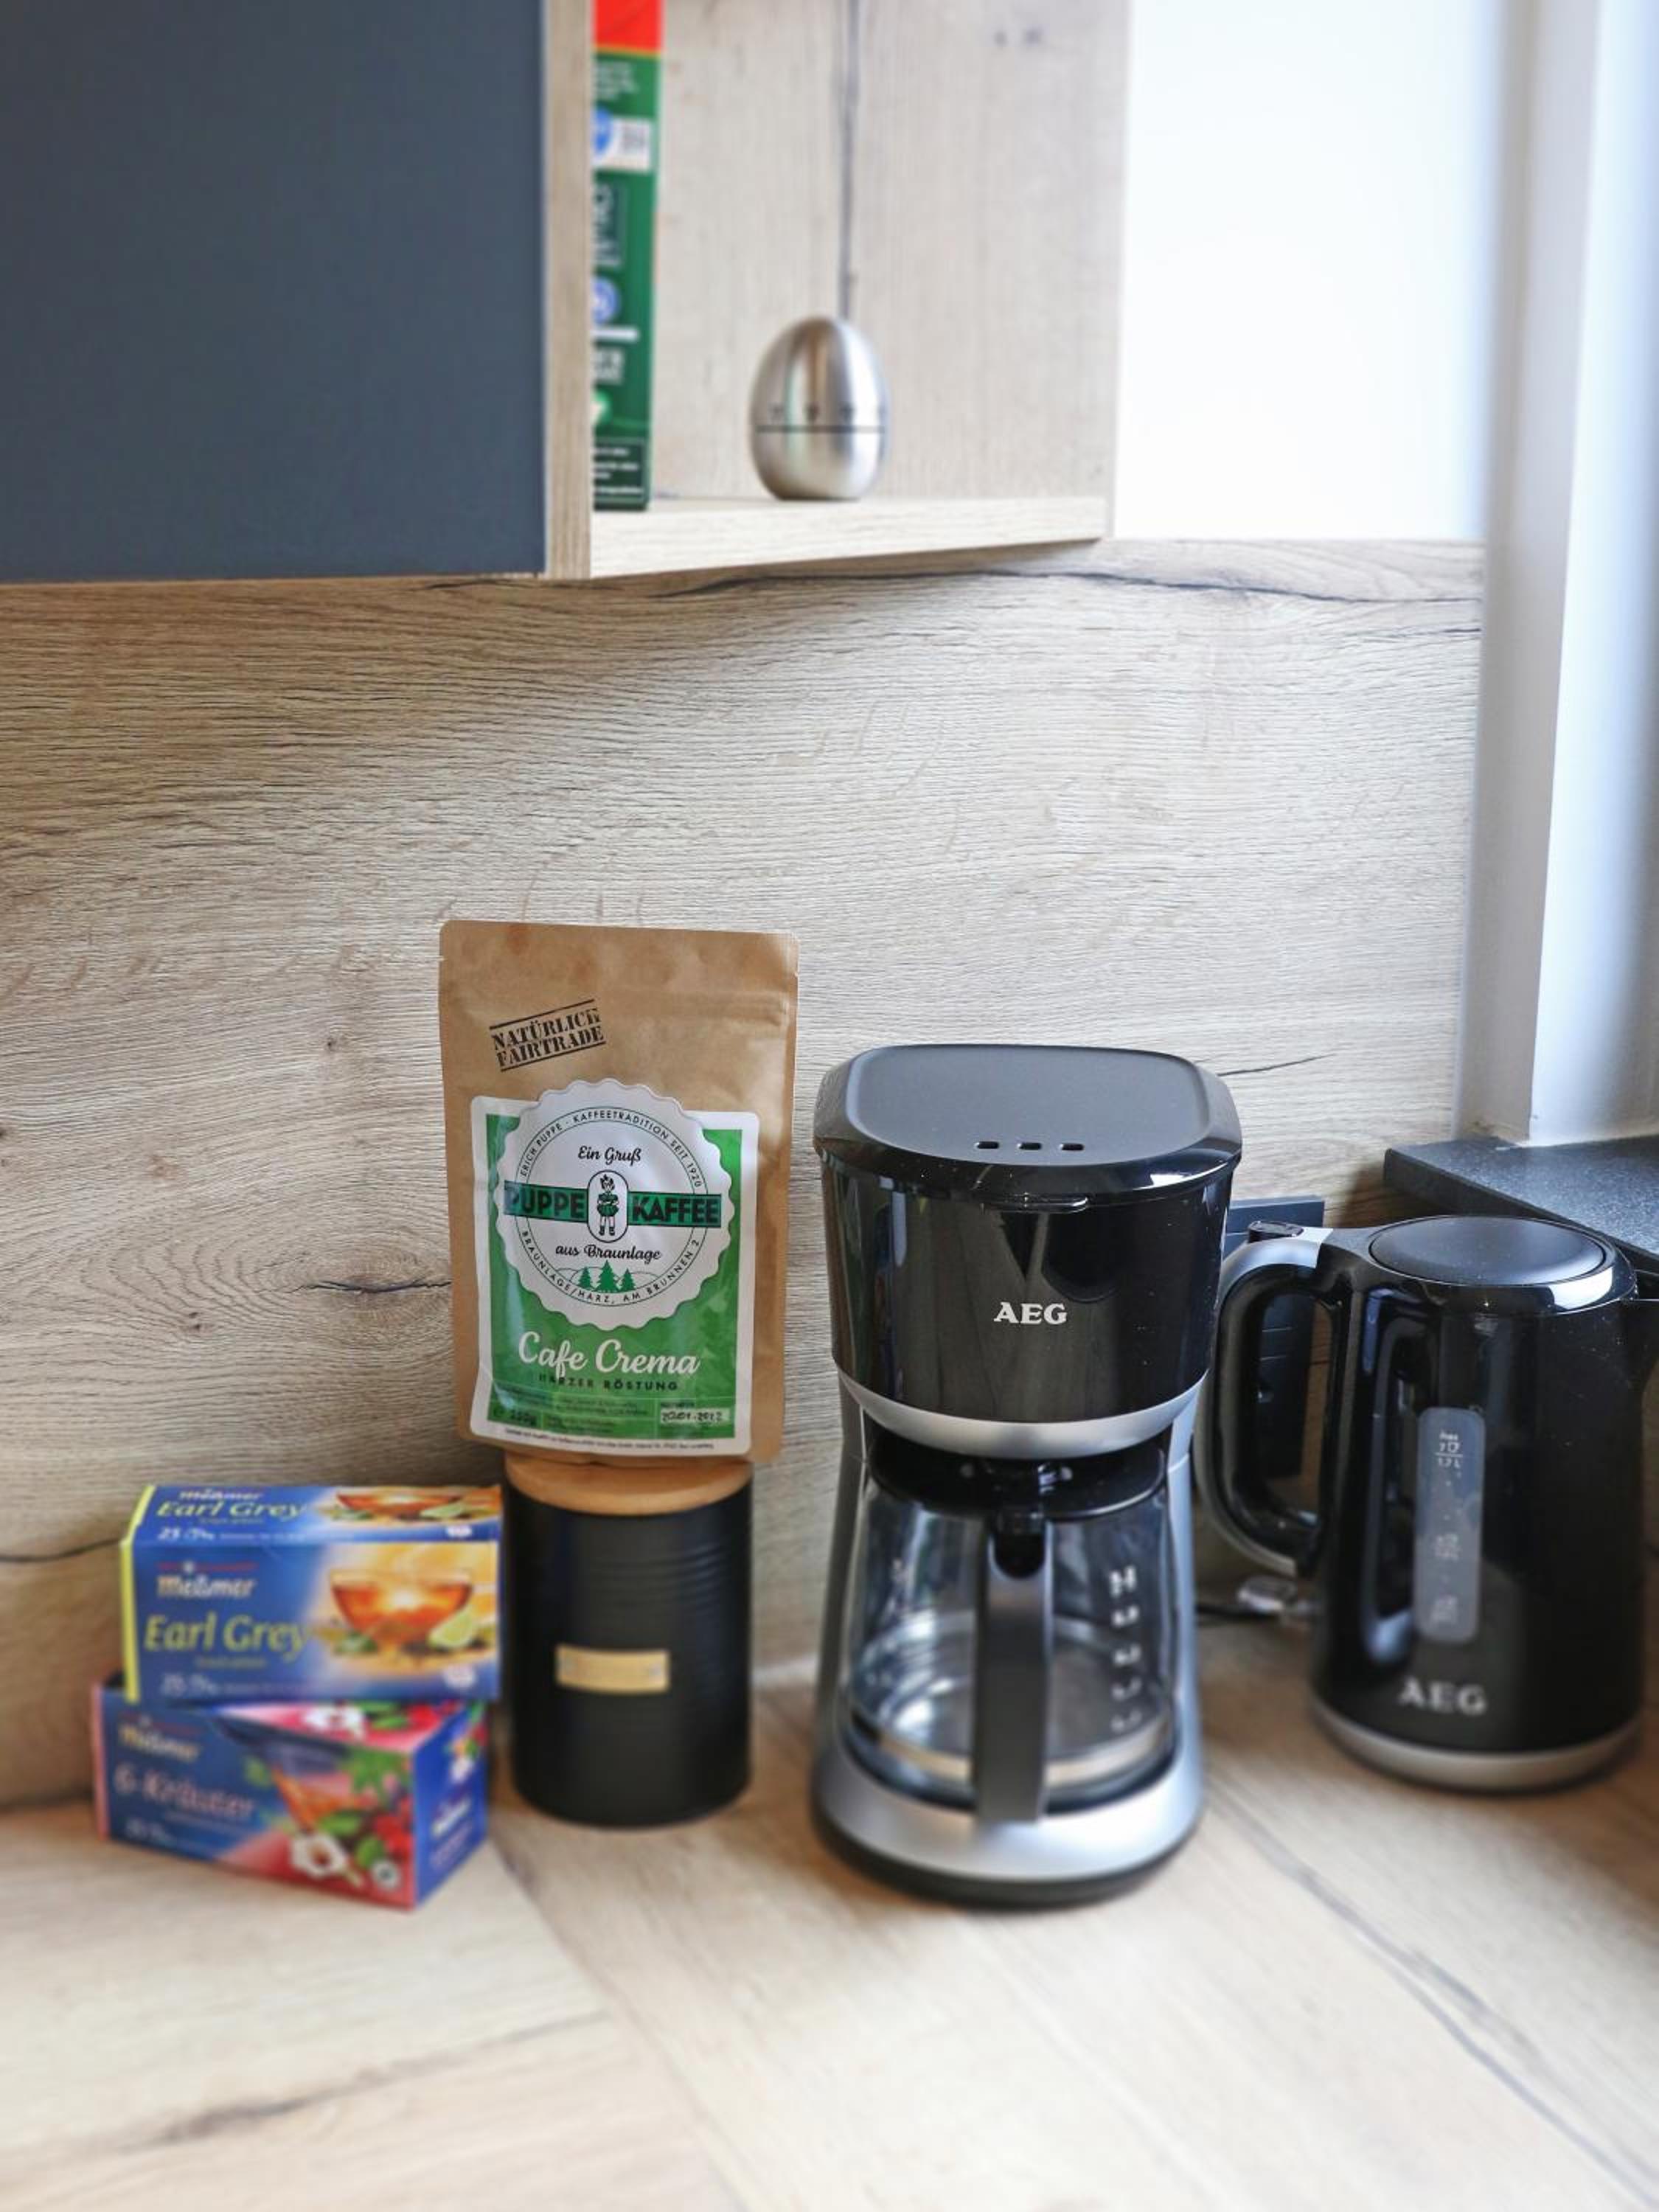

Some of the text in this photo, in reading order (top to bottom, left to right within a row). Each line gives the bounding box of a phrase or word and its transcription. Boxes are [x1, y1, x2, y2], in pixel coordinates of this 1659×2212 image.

[496, 1026, 604, 1068] FAIRTRADE
[521, 1148, 538, 1178] ERICH
[536, 1123, 563, 1147] PUPPE
[572, 1110, 669, 1140] KAFFEETRADITION
[670, 1139, 689, 1160] SEIT
[577, 1145, 641, 1166] Ein Gruß
[632, 1194, 719, 1223] KAFFEE
[555, 1244, 662, 1265] aus Braunlage
[623, 1293, 641, 1302] AM
[647, 1251, 694, 1295] BRUNNEN
[993, 1301, 1068, 1325] AEG
[518, 1331, 700, 1380] Cafe Crema
[603, 1378, 678, 1391] RÖSTUNG
[157, 1500, 305, 1522] Earl Grey
[145, 1610, 305, 1664] Earl Grey
[1397, 1674, 1488, 1717] AEG
